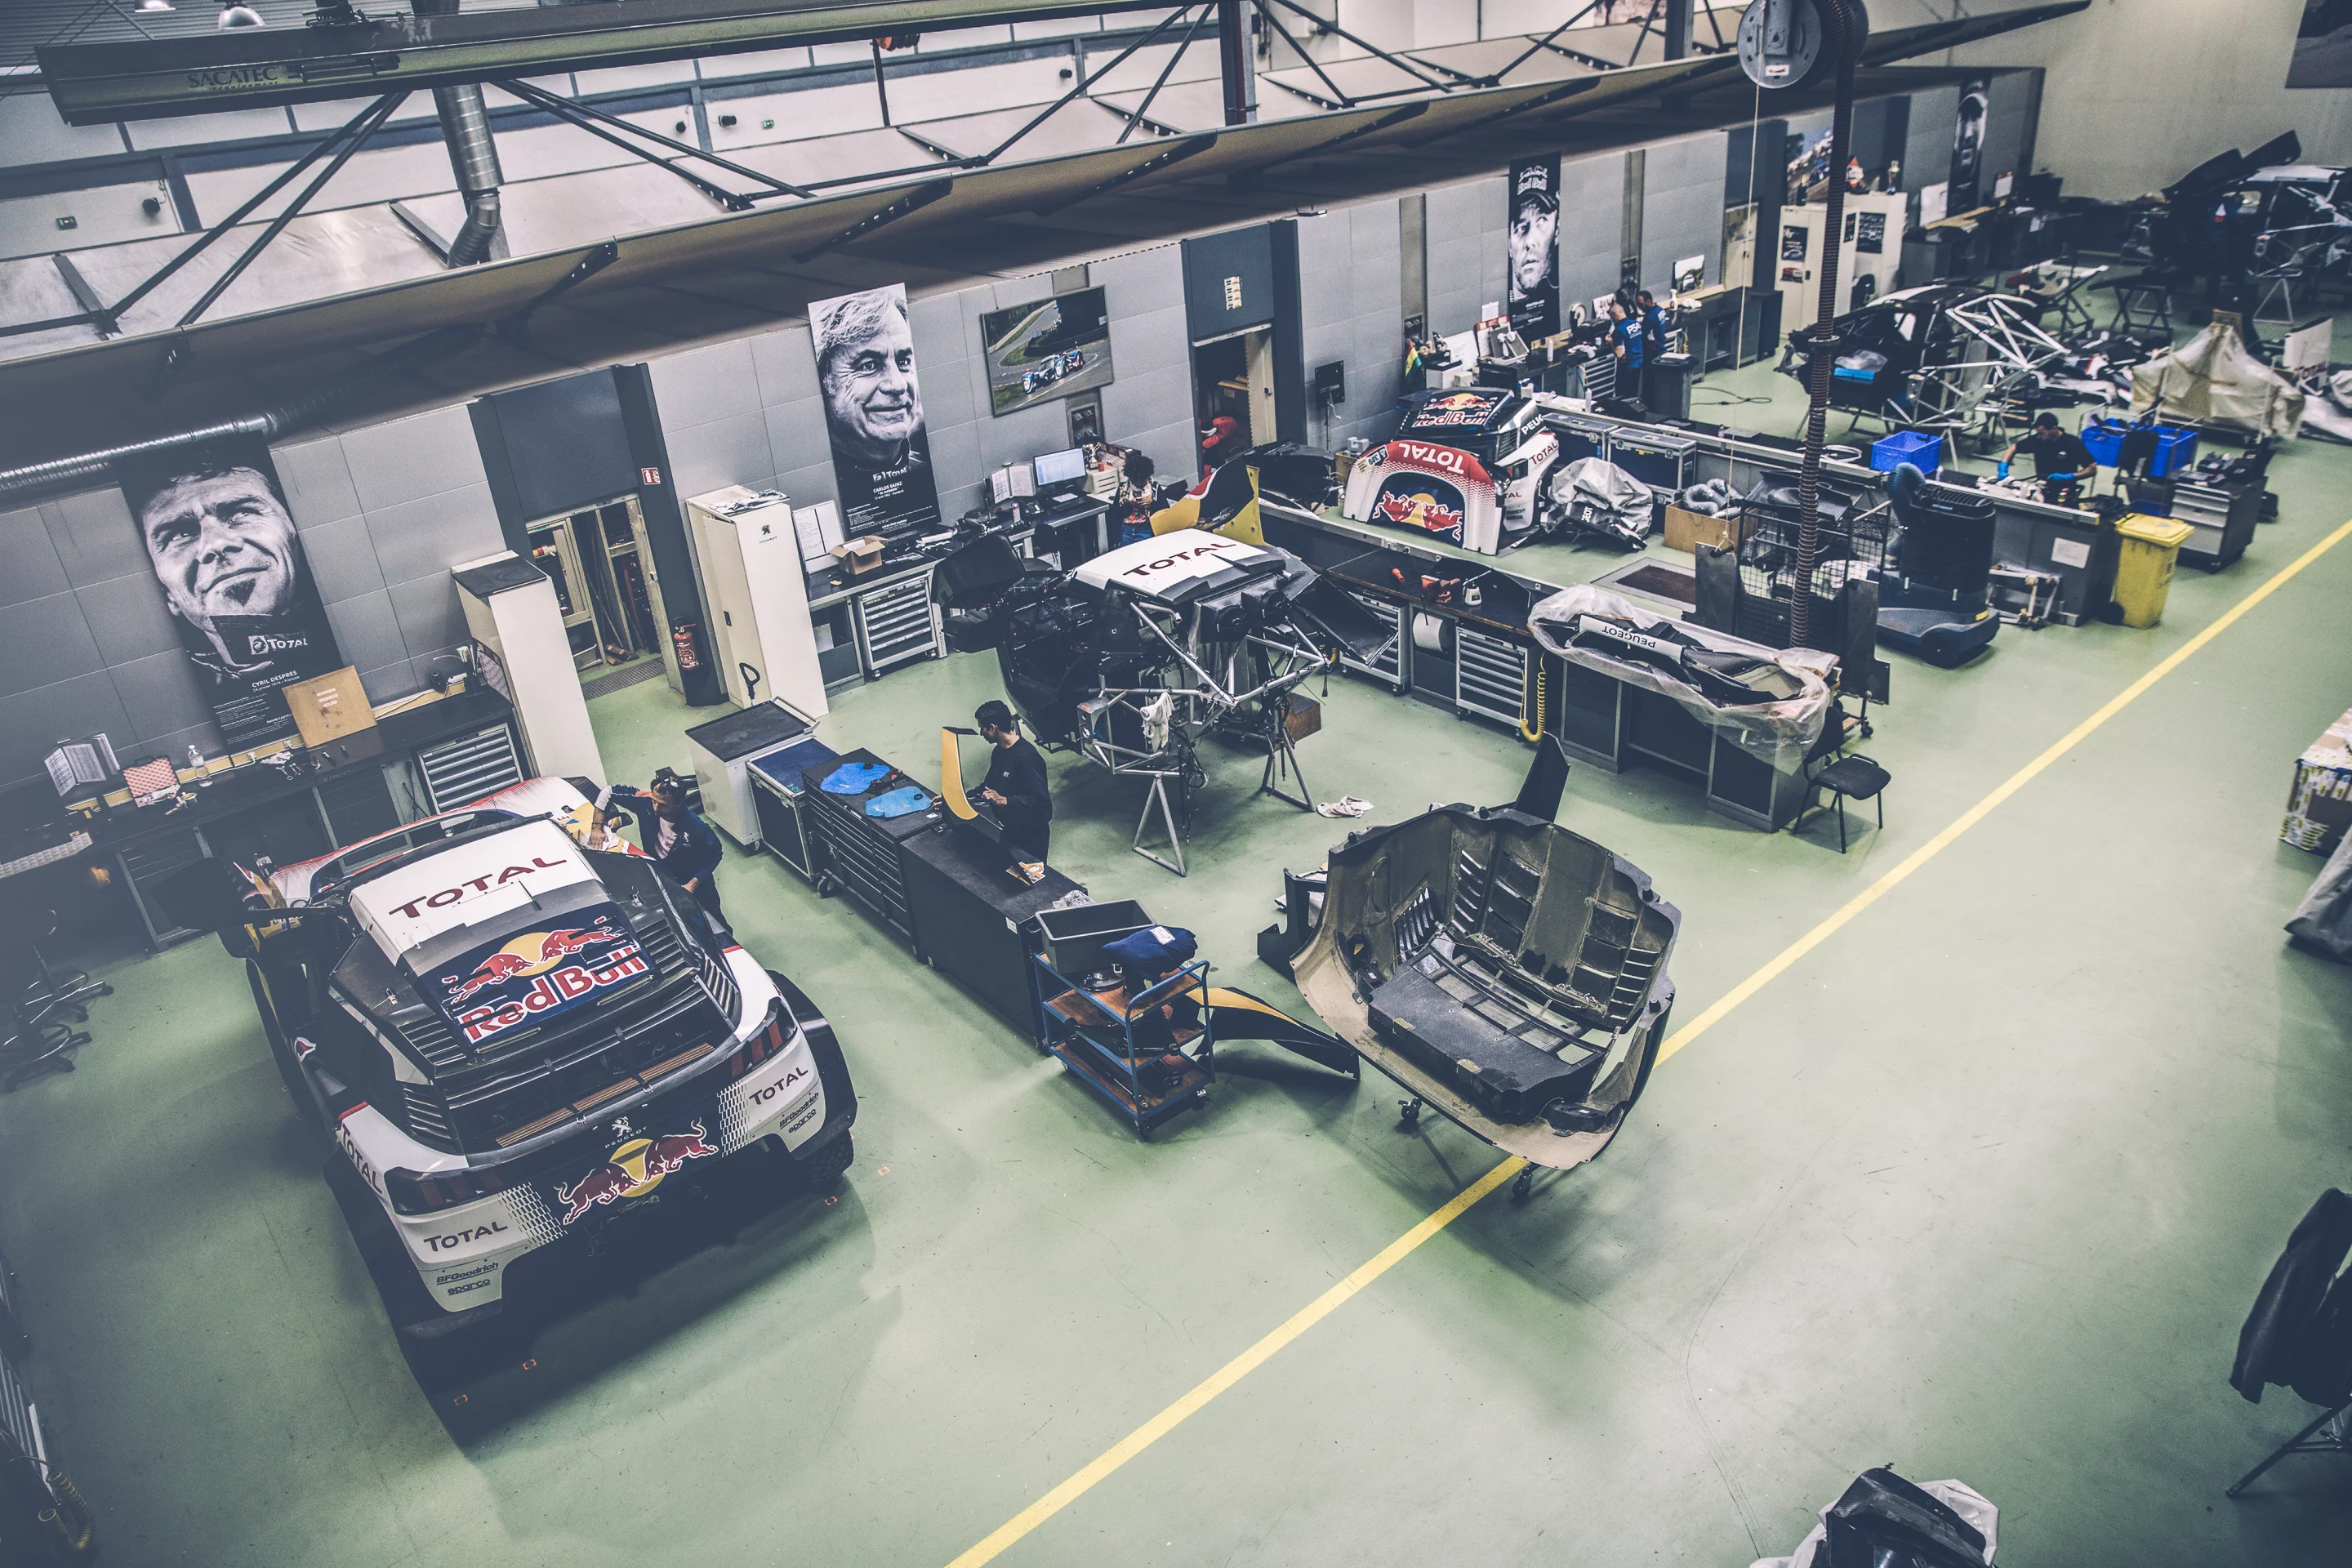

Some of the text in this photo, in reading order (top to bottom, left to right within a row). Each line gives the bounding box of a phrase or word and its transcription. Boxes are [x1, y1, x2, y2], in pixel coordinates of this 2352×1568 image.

[187, 67, 278, 87] SACATEC
[1398, 443, 1464, 474] TOTAL
[1528, 442, 1558, 466] TOTAL
[873, 484, 889, 493] CARLOS
[1122, 543, 1236, 576] TOTAL
[267, 638, 309, 649] TOTAL
[1601, 626, 1656, 648] PEUGEOT
[252, 670, 297, 688] CYRIL DESPRES
[389, 858, 567, 918] TOTAL
[458, 945, 650, 1044] Red Bull
[749, 1067, 808, 1105] TOTAL
[779, 1092, 819, 1129] BFGoodrich
[604, 1126, 648, 1148] PEUGEOT
[342, 1123, 382, 1194] TOTAL
[423, 1221, 508, 1252] TOTAL
[436, 1262, 499, 1285] BFGoodrich
[447, 1278, 491, 1296] sparco
